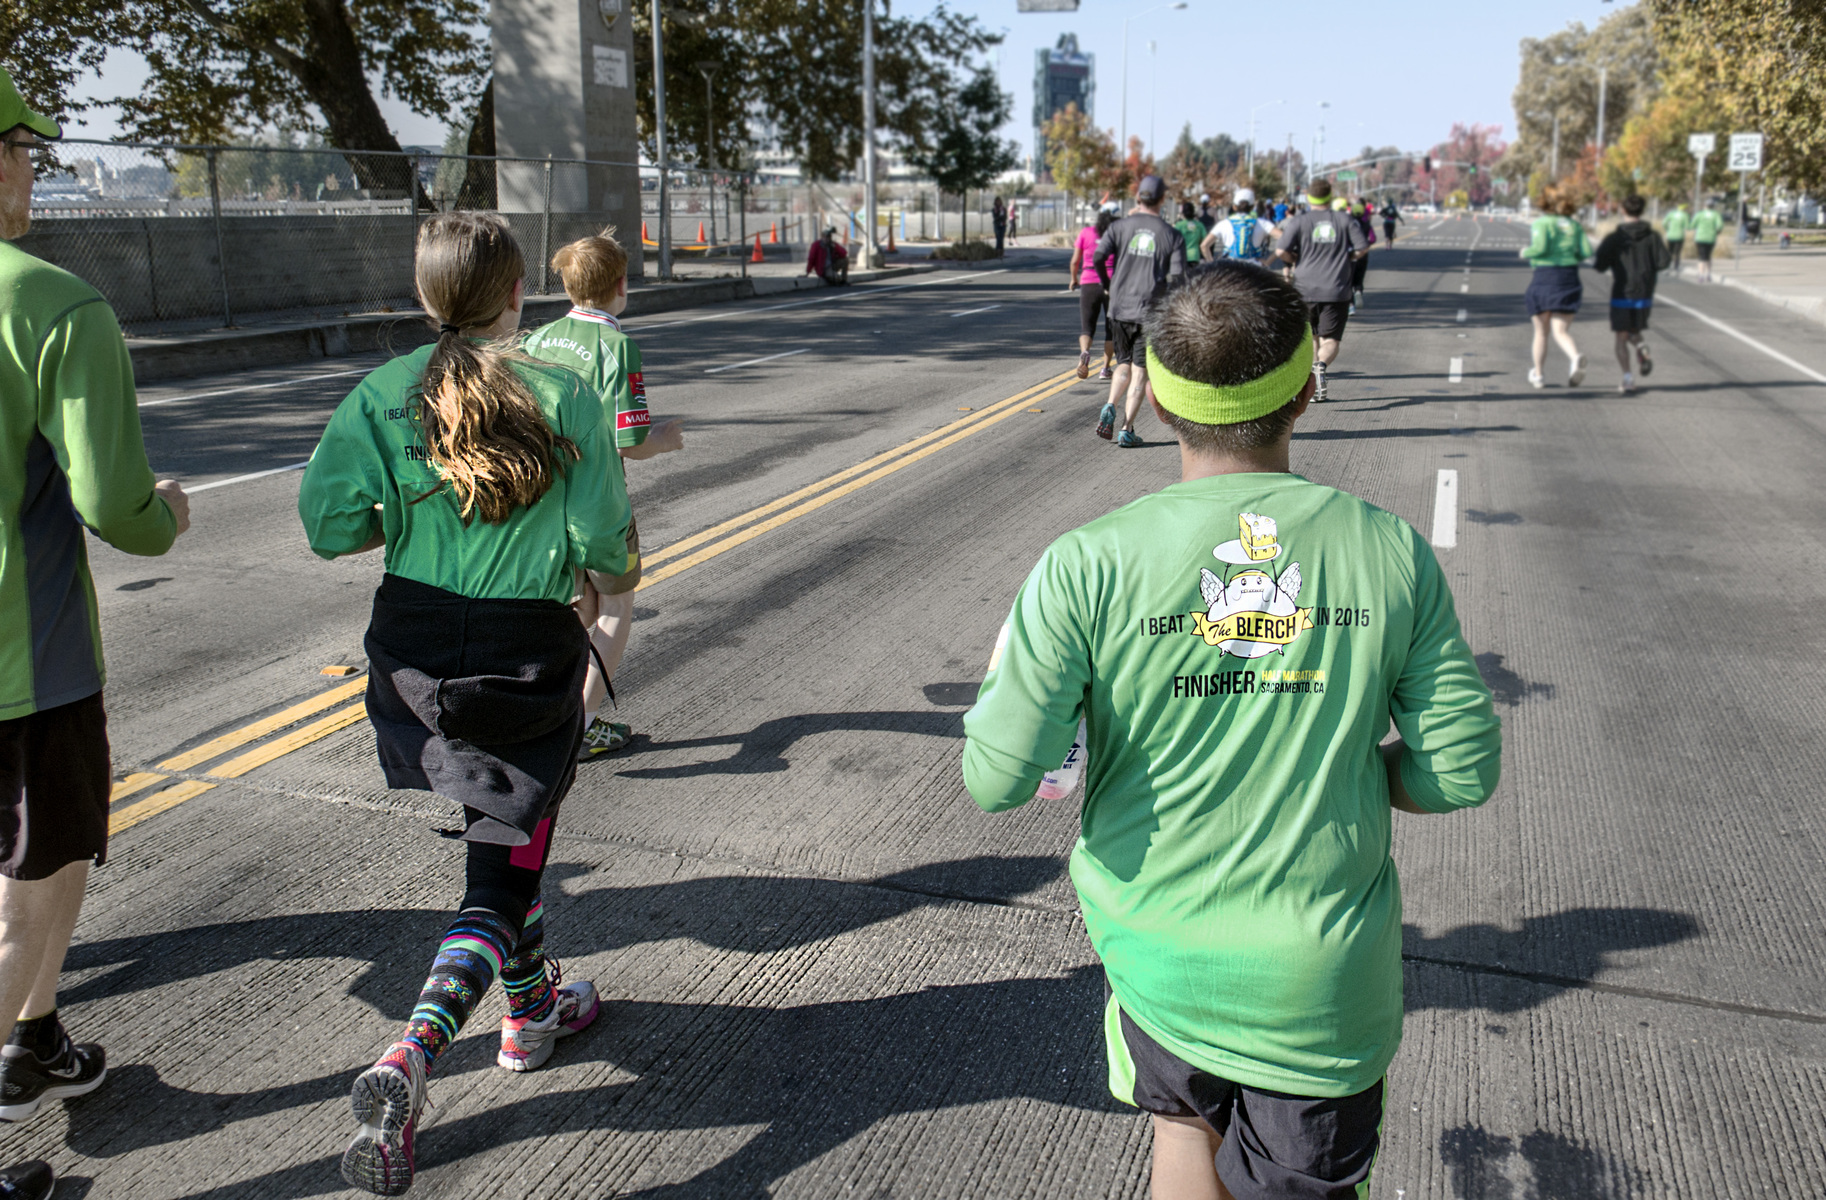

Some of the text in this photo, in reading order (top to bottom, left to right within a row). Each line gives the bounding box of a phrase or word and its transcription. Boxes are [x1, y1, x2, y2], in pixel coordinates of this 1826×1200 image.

[1733, 152, 1757, 166] 25
[541, 338, 592, 361] MAIGH EO
[388, 407, 410, 420] BEAT
[1140, 606, 1370, 640] I BEAT The BLERCH IN 2015
[1262, 669, 1326, 681] HALF MARATHON
[1174, 670, 1255, 698] FINISHER
[1260, 682, 1324, 694] SACRAMENTO, CA
